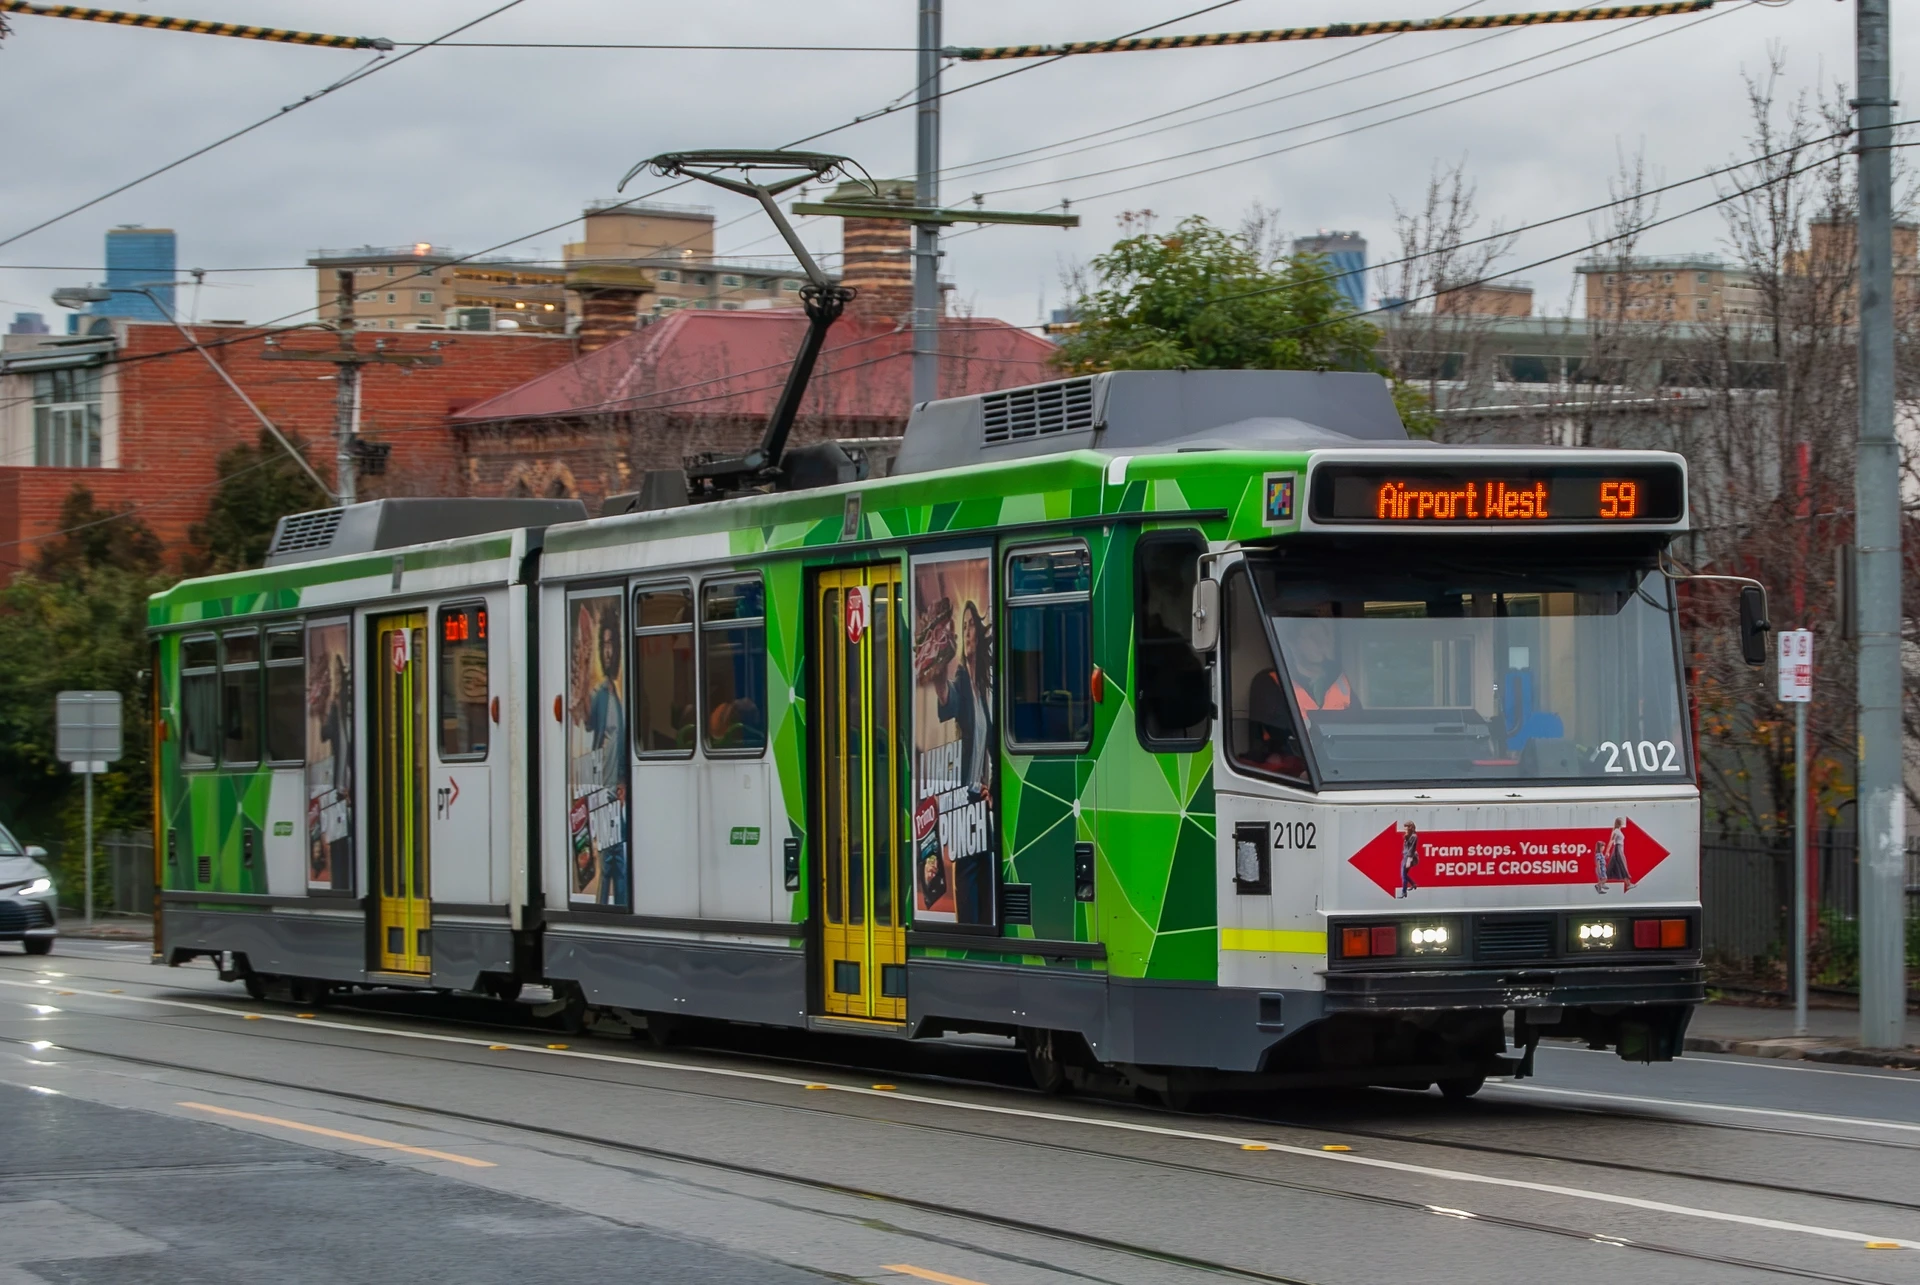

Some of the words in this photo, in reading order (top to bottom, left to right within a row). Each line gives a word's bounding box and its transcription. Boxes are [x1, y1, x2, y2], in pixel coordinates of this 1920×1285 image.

[1378, 482, 1478, 520] Airport
[1485, 482, 1549, 519] West
[1600, 481, 1637, 519] 59
[919, 739, 963, 799] LUNCH
[1600, 740, 1680, 774] 2102
[915, 803, 935, 836] Primo
[939, 800, 988, 862] PUNCH
[1273, 821, 1318, 850] 2102
[1422, 843, 1464, 858] Tram
[1467, 843, 1516, 859] stops.
[1519, 841, 1549, 856] You
[1552, 841, 1592, 858] stop.
[1435, 861, 1495, 877] PEOPLE
[1498, 859, 1579, 875] CROSSING
